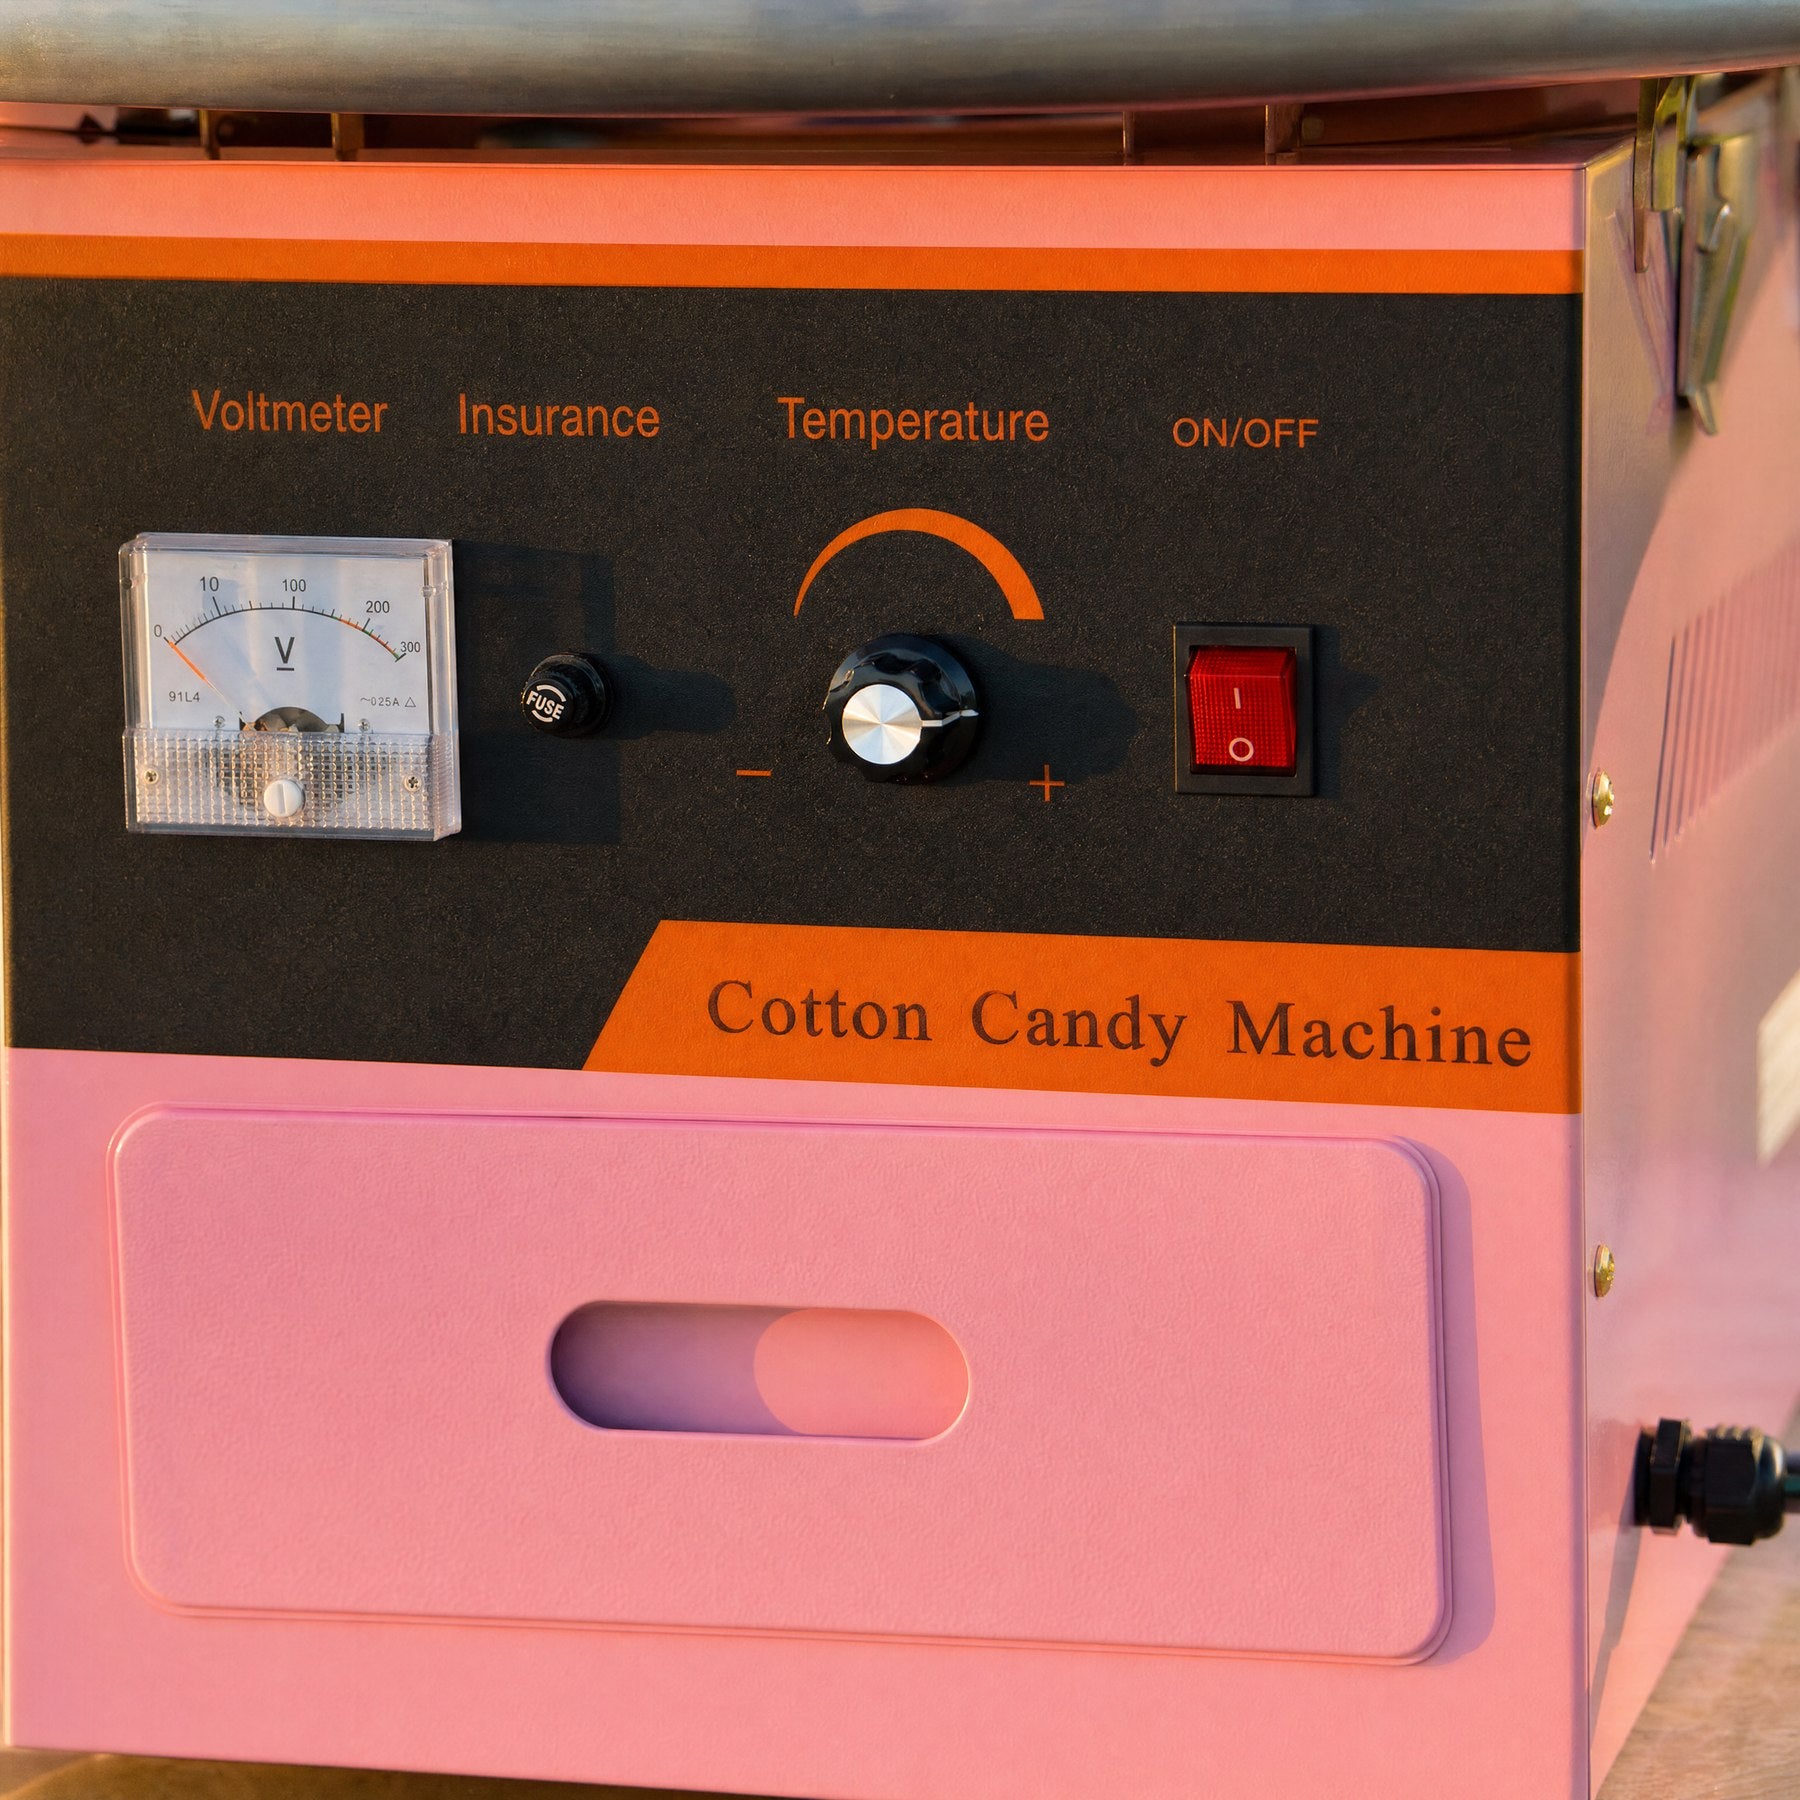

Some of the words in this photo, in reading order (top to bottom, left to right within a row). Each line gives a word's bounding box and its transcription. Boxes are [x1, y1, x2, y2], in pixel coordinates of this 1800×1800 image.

[192, 389, 389, 433] Voltmeter
[459, 392, 660, 437] Insurance
[777, 397, 1050, 450] Temperature
[1172, 417, 1319, 448] ON/OFF
[199, 576, 220, 592] 10
[281, 578, 307, 593] 100
[365, 600, 391, 614] 200
[153, 624, 163, 638] 0
[274, 636, 295, 664] V
[400, 641, 421, 653] 300
[168, 690, 201, 703] 91L4
[525, 690, 565, 720] FUSE
[707, 979, 933, 1041] Cotton
[971, 989, 1188, 1068] Candy
[1226, 1000, 1531, 1067] Machine
